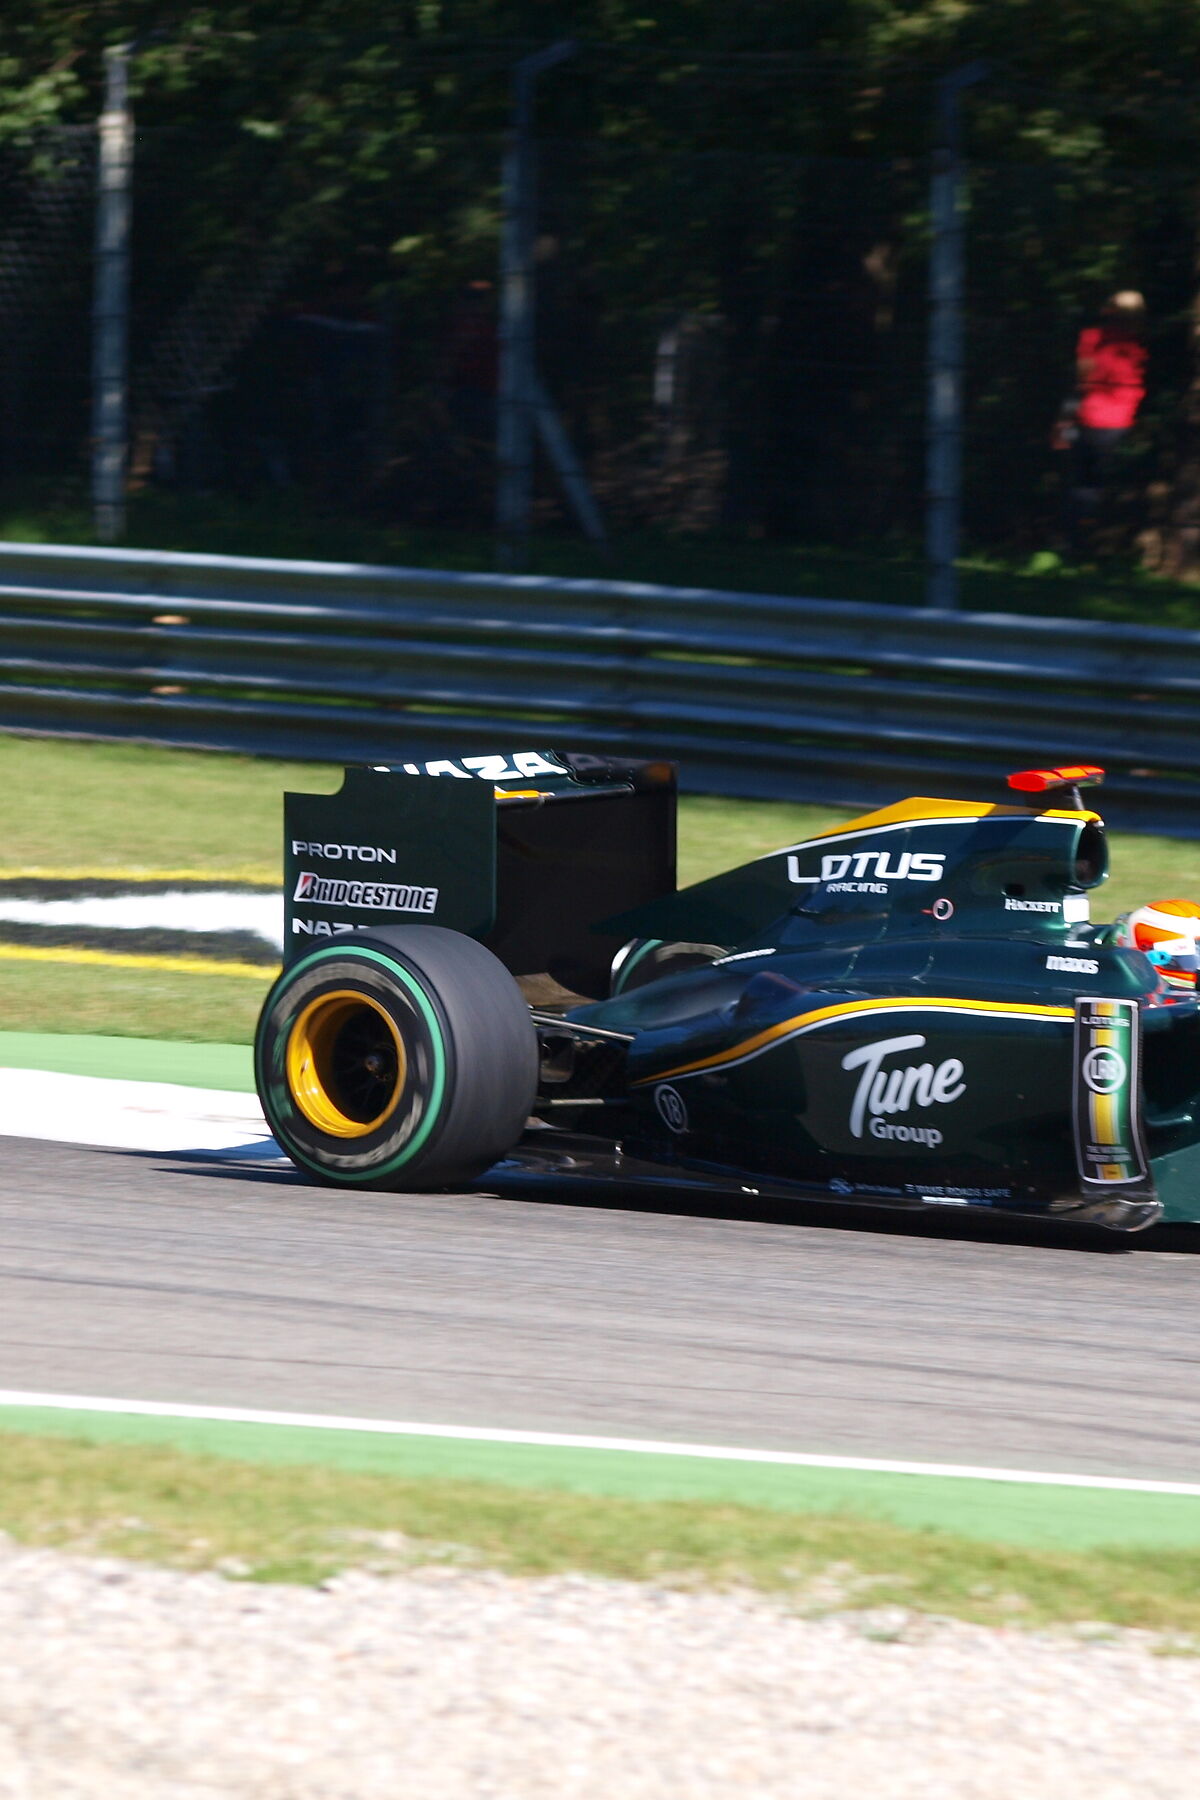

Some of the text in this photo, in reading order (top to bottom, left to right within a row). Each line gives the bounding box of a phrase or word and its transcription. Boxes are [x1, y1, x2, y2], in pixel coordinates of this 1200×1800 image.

[292, 840, 397, 863] PROTON
[788, 851, 946, 884] LOTUS
[299, 874, 435, 910] BRIDGESTONE
[826, 882, 888, 894] RACING
[1005, 898, 1061, 913] HACKETT
[292, 918, 370, 936] NAZ
[841, 1034, 967, 1138] Tune
[869, 1117, 943, 1148] Group
